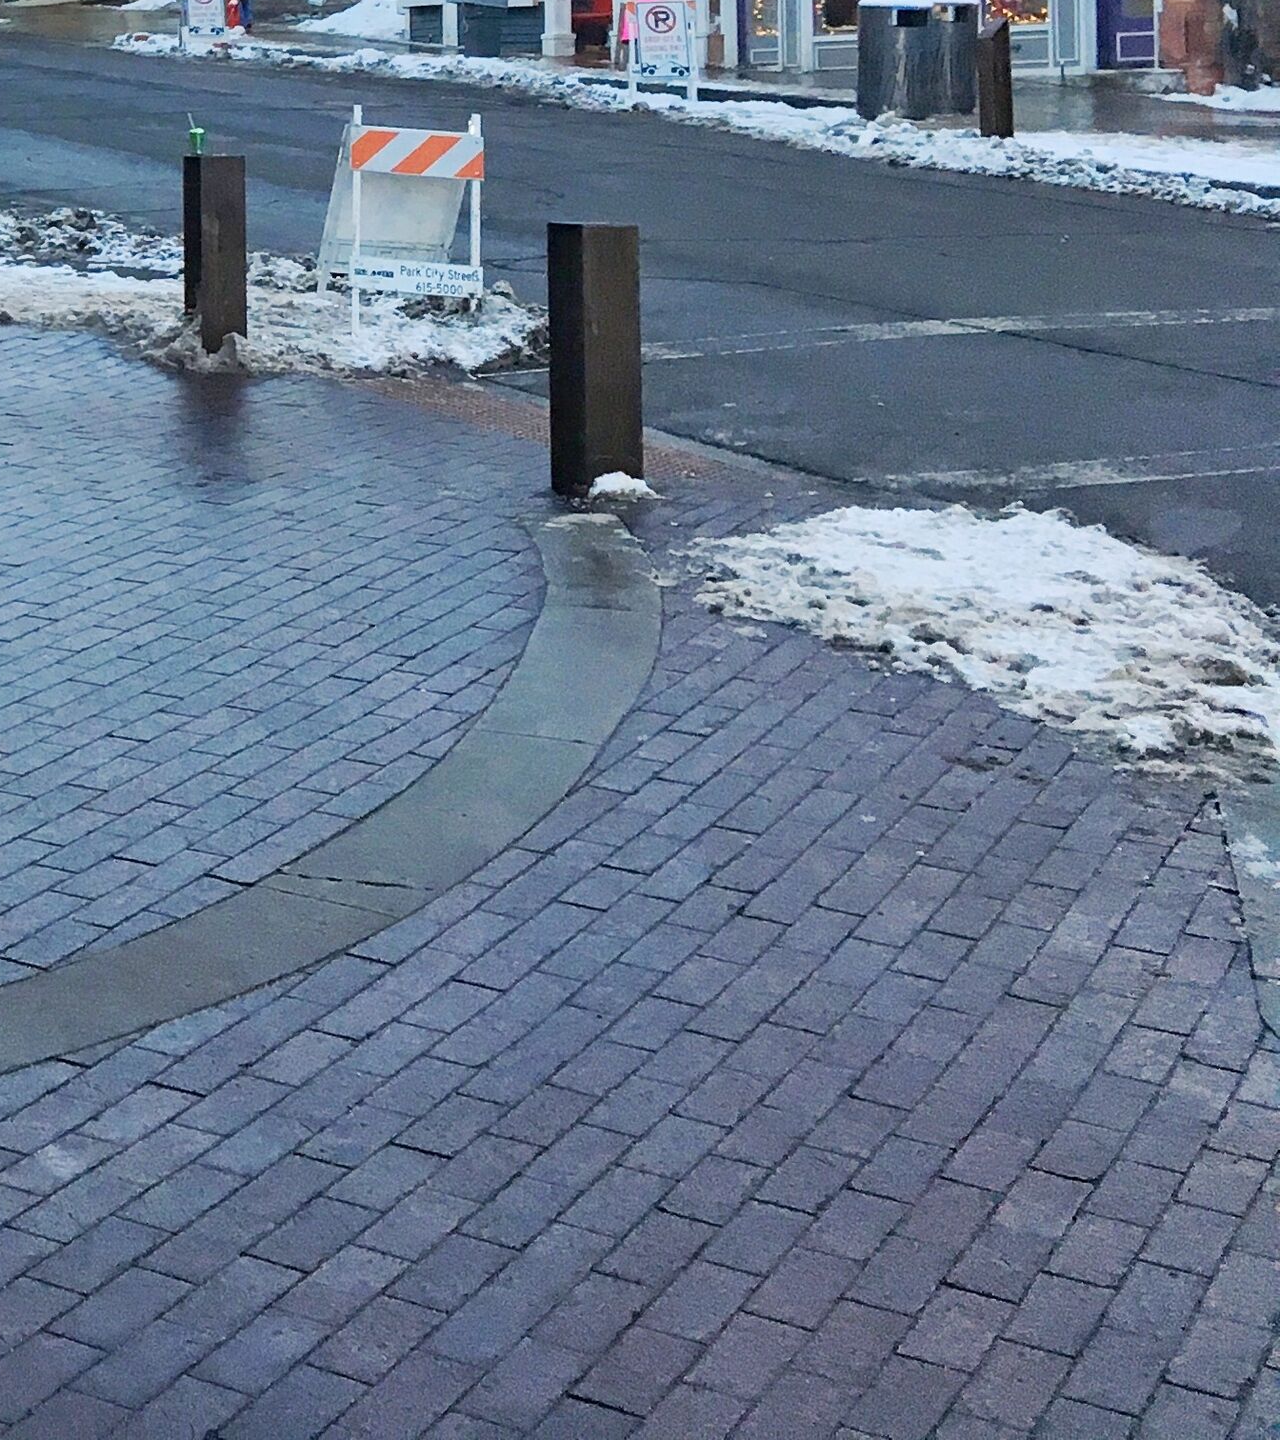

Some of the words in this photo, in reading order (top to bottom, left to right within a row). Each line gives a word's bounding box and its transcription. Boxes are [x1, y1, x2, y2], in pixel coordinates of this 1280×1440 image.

[400, 265, 421, 278] Park
[425, 267, 444, 281] City
[448, 269, 480, 283] Streets
[415, 282, 464, 295] 615-5000
